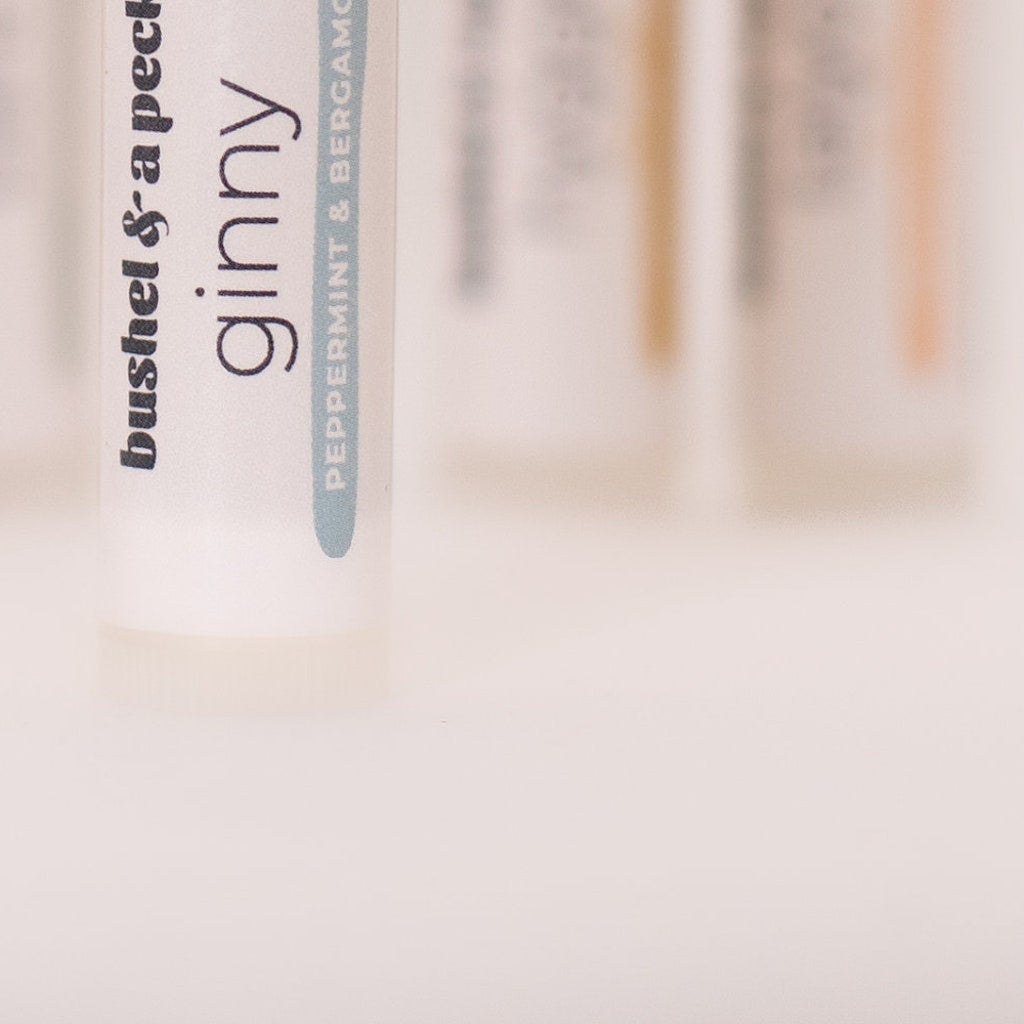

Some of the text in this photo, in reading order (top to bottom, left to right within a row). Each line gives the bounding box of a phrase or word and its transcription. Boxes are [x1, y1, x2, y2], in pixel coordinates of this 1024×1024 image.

[122, 190, 169, 248] &
[131, 144, 161, 185] a
[195, 77, 302, 376] ginny
[328, 199, 351, 223] &
[120, 259, 159, 470] bushel
[326, 238, 349, 491] PEPPERMINT
